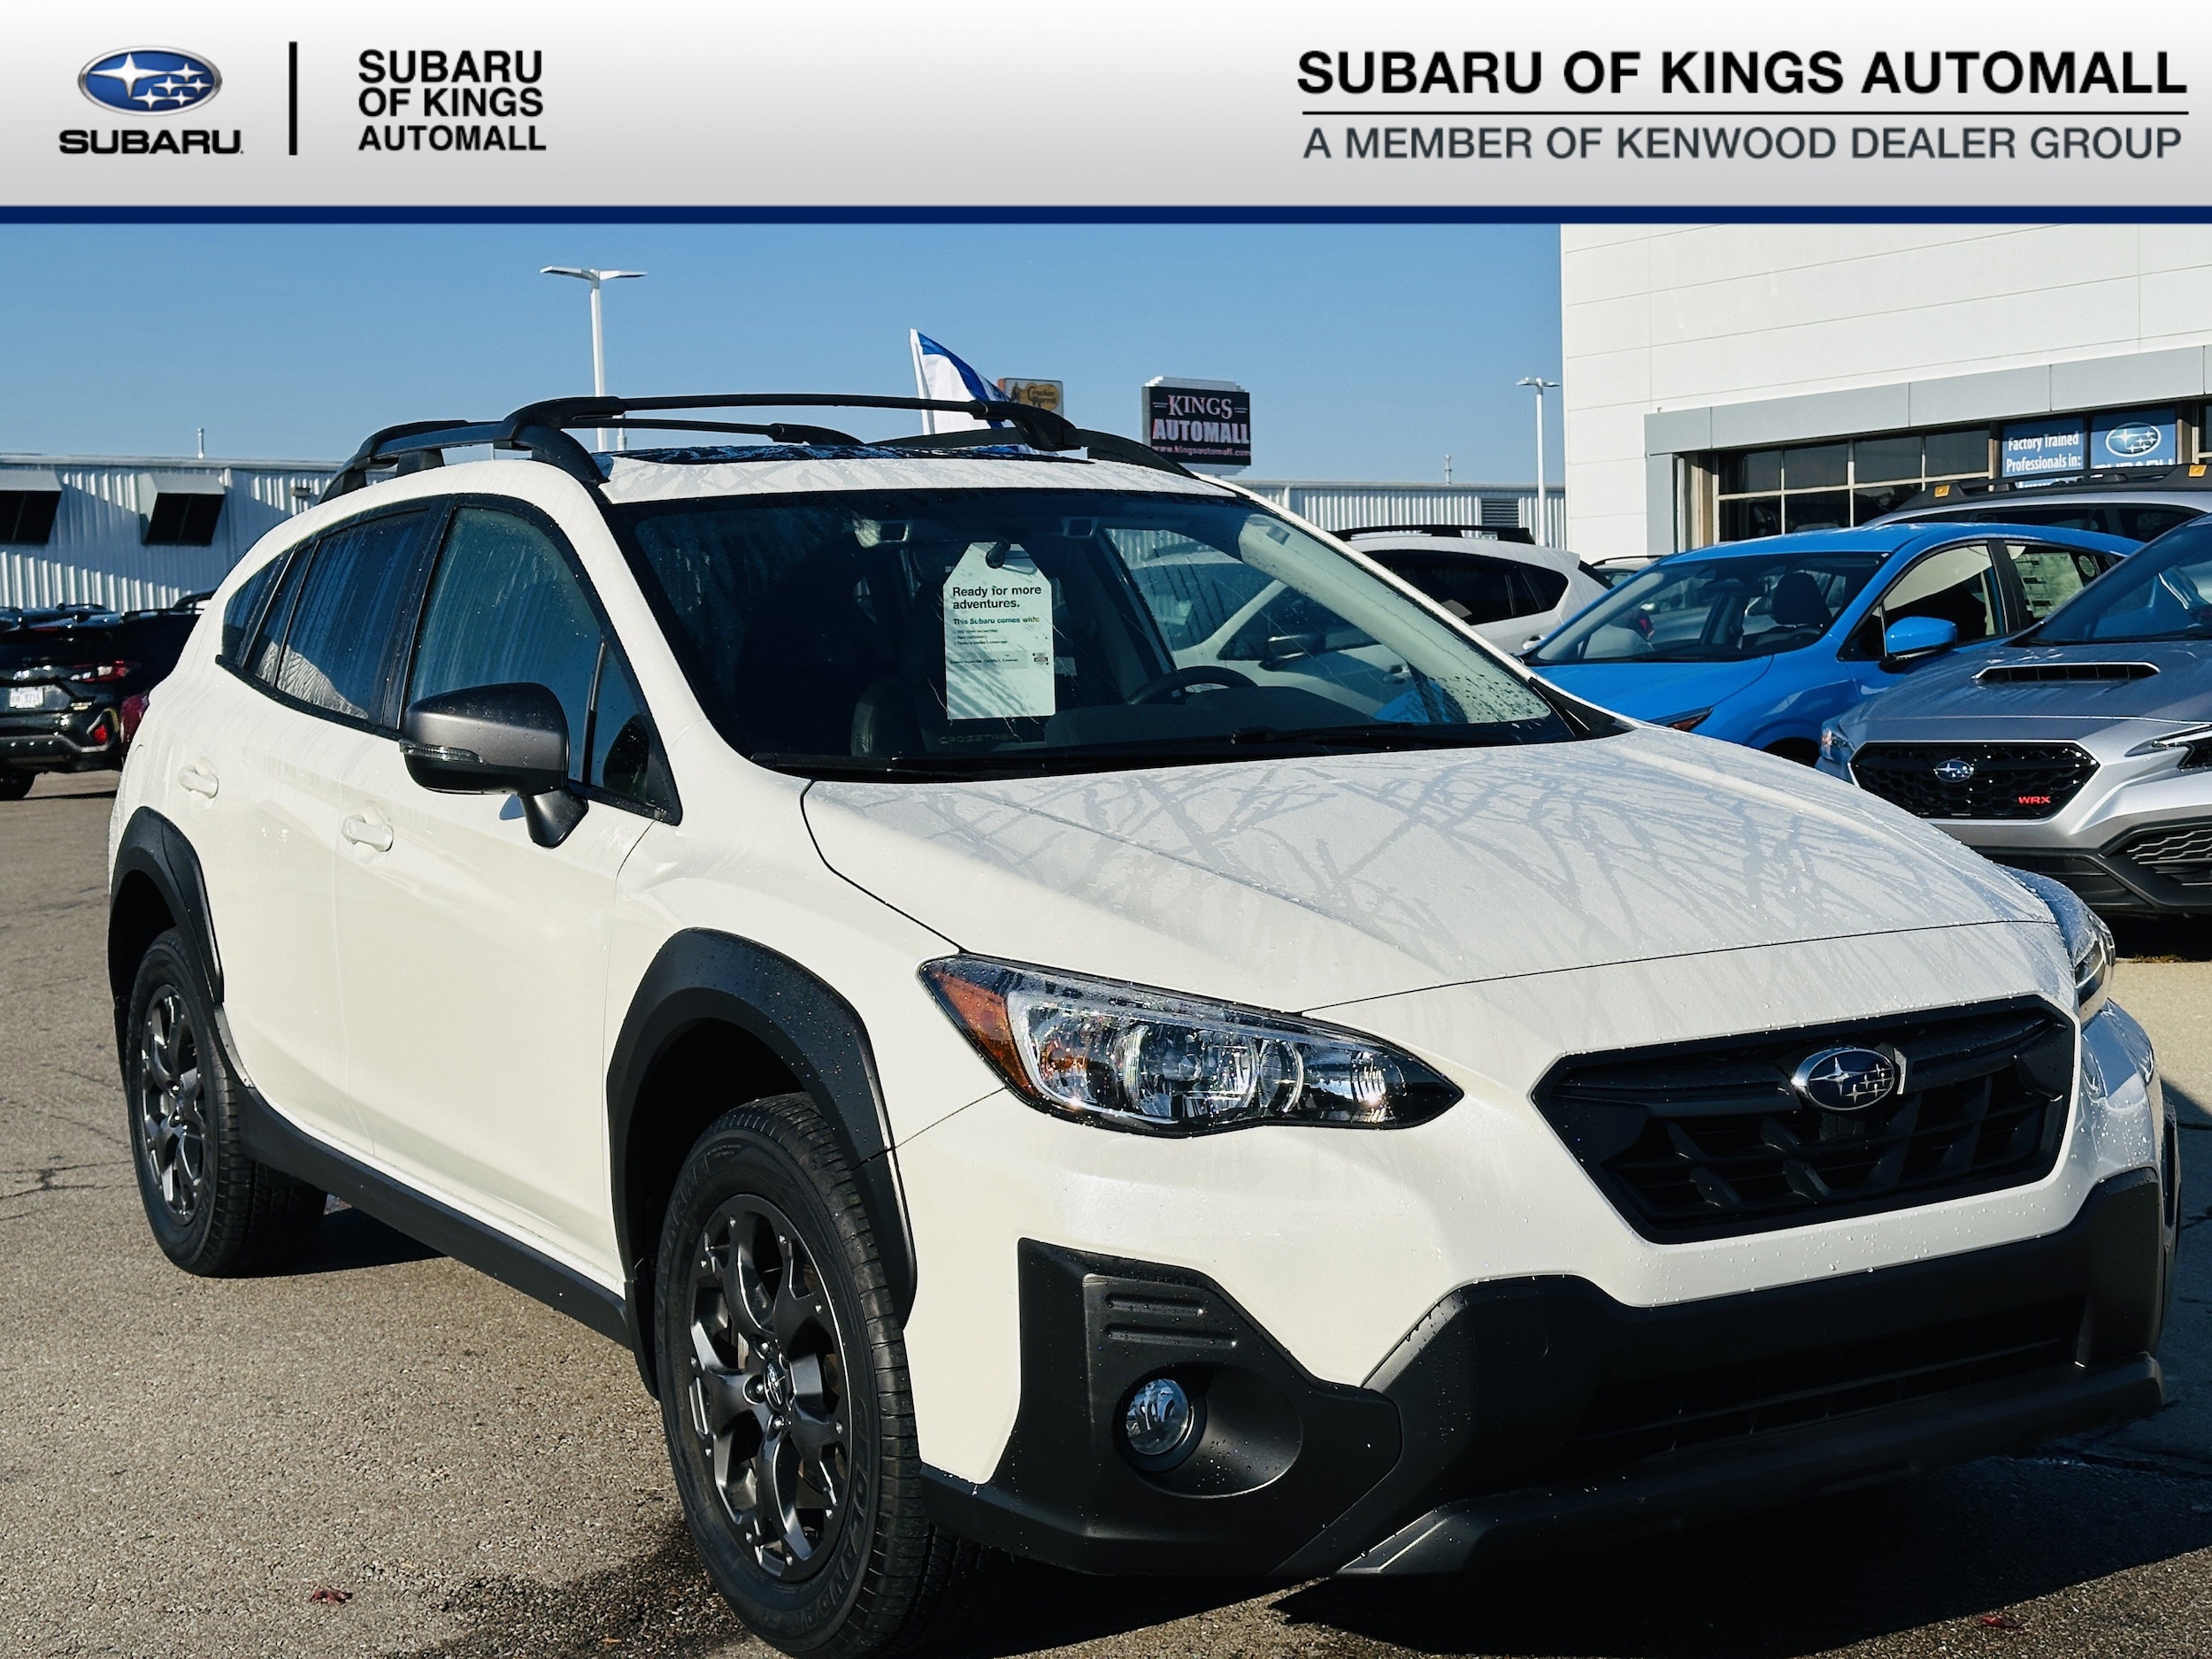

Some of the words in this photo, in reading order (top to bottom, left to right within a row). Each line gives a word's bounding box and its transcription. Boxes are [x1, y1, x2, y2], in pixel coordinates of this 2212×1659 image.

[1168, 395, 1233, 420] KINGS
[1152, 419, 1250, 444] AUTOMALL
[2008, 437, 2043, 452] Factory
[2044, 431, 2079, 448] Trained
[2006, 453, 2068, 472] Professionals
[2068, 452, 2082, 468] in:
[952, 587, 988, 598] Ready
[991, 585, 1009, 595] for
[1011, 587, 1042, 595] more
[952, 599, 1020, 610] adventures.
[939, 733, 1013, 744] CROSSTRE
